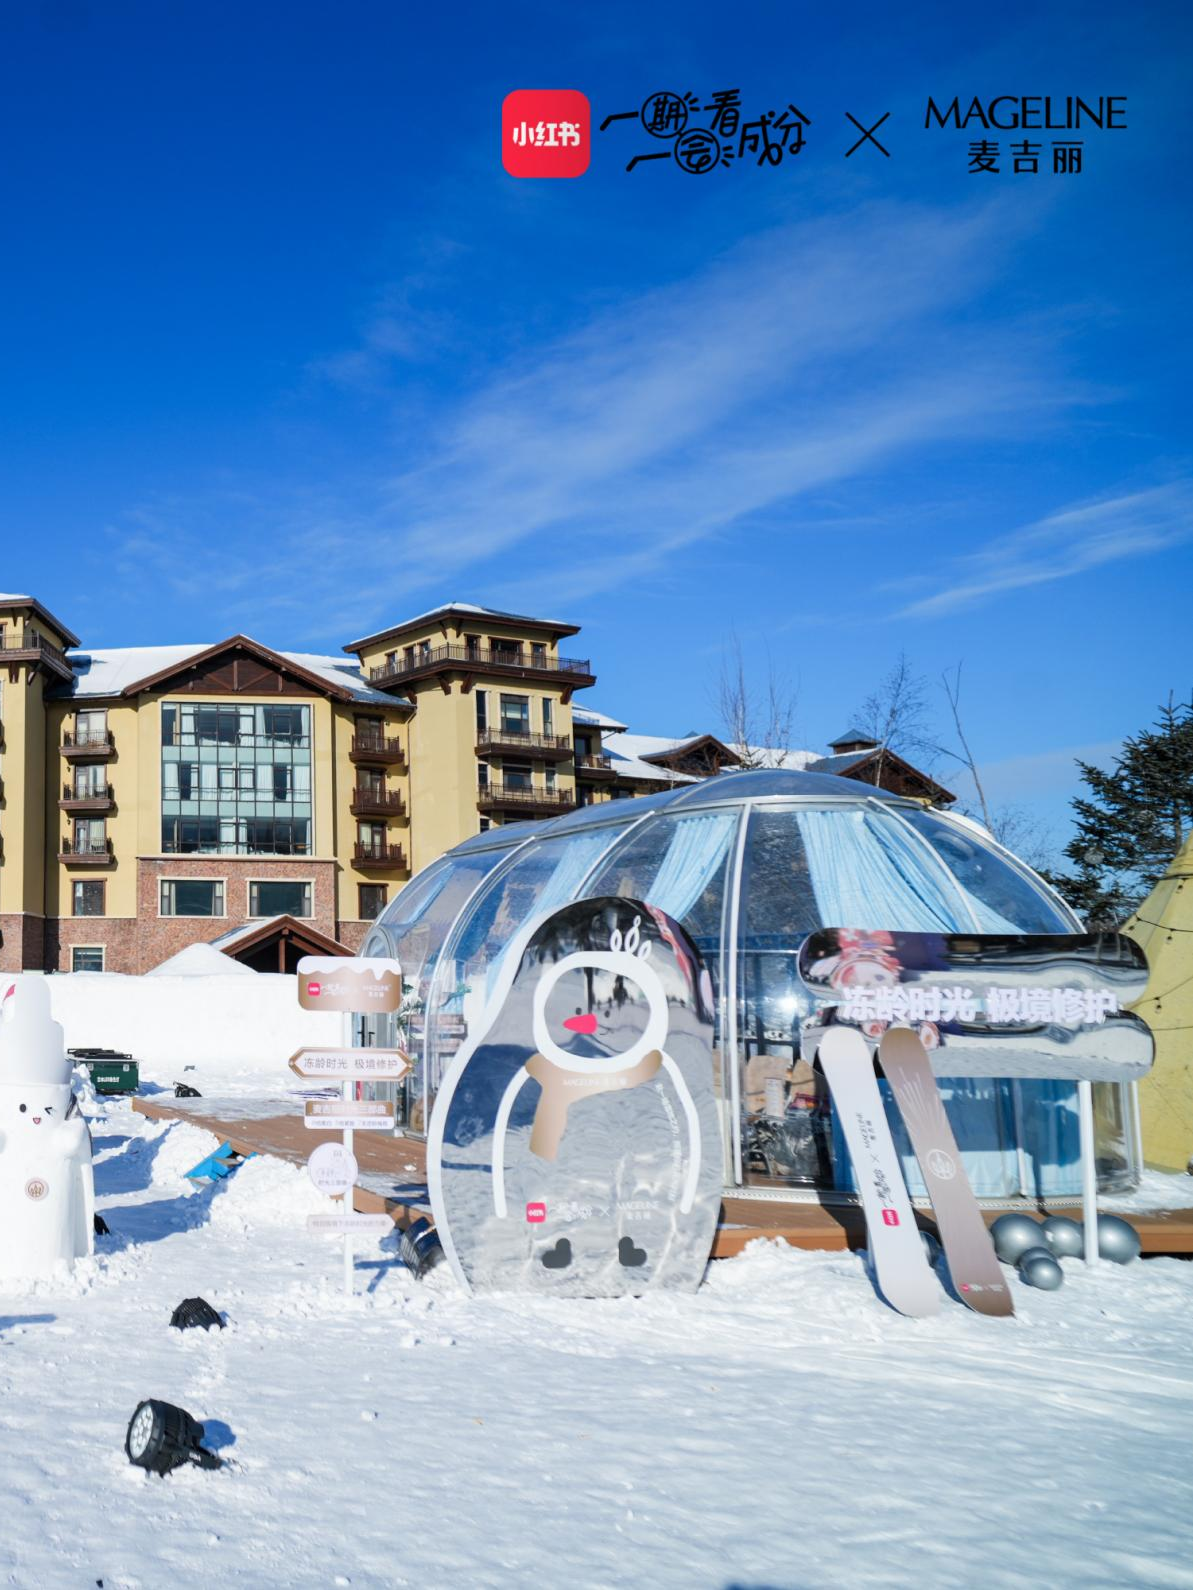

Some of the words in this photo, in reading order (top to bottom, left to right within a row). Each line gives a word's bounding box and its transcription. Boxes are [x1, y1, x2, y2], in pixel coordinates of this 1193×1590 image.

[842, 986, 977, 1023] 冻龄时光
[983, 986, 1123, 1025] 极境修护
